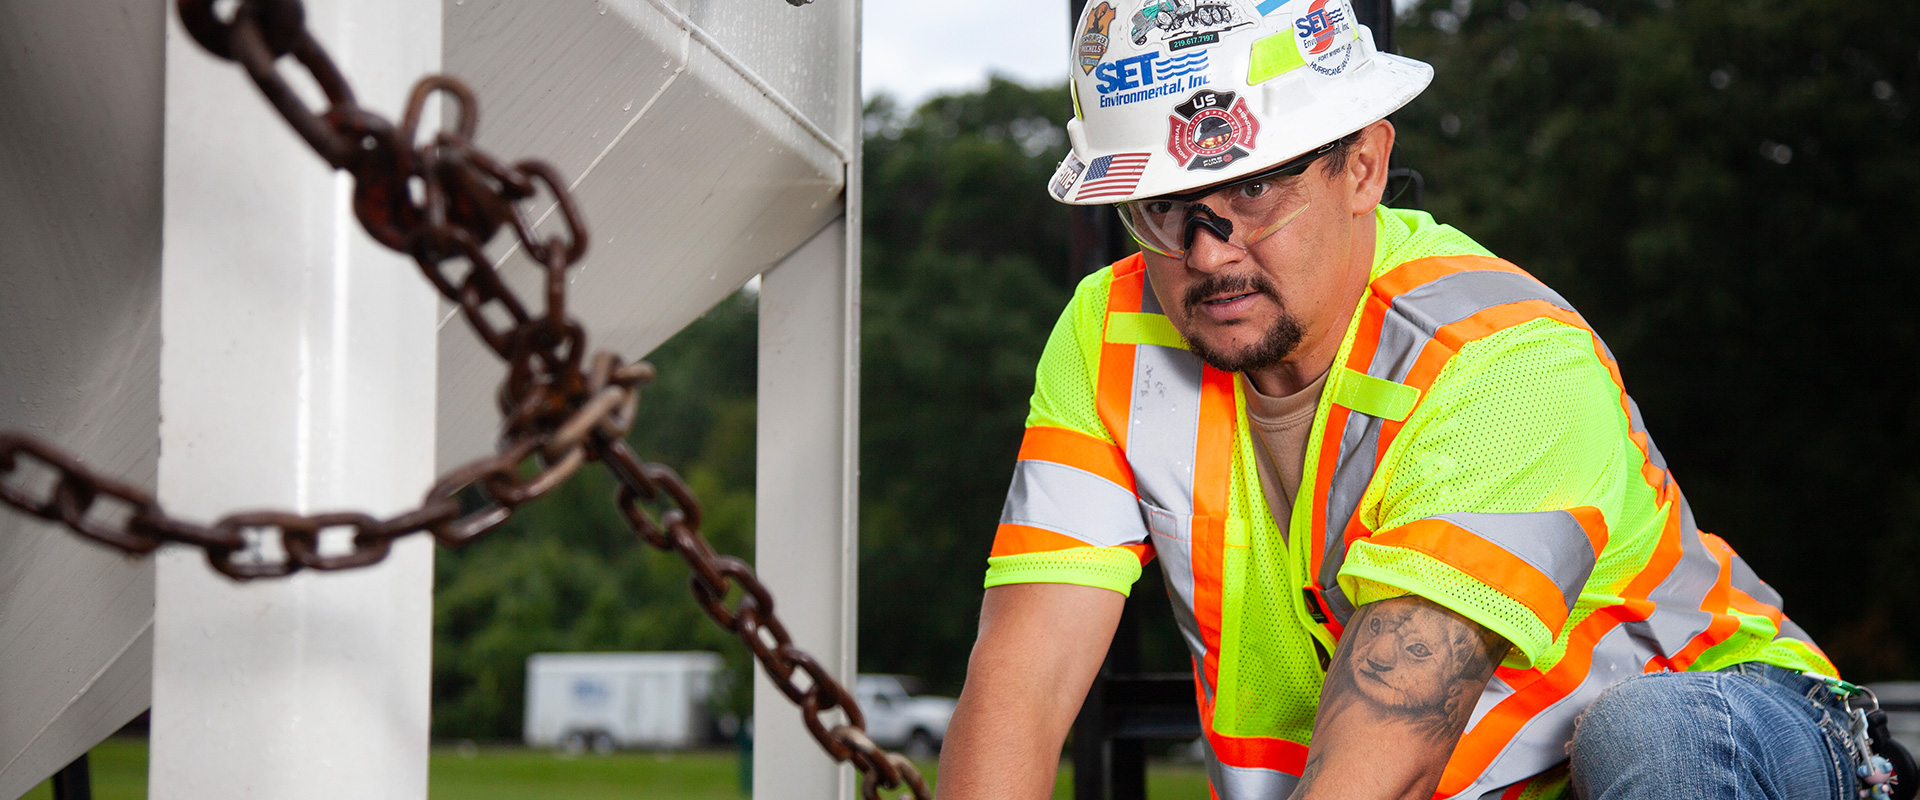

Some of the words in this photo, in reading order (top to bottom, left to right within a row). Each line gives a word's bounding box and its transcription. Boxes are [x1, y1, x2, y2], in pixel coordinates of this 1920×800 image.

[1295, 8, 1329, 38] SET
[1173, 34, 1214, 48] 219.617.7197
[1095, 51, 1160, 94] SET
[1309, 60, 1342, 76] HURRICANE
[1100, 78, 1185, 108] Environmental,
[1193, 93, 1217, 110] US
